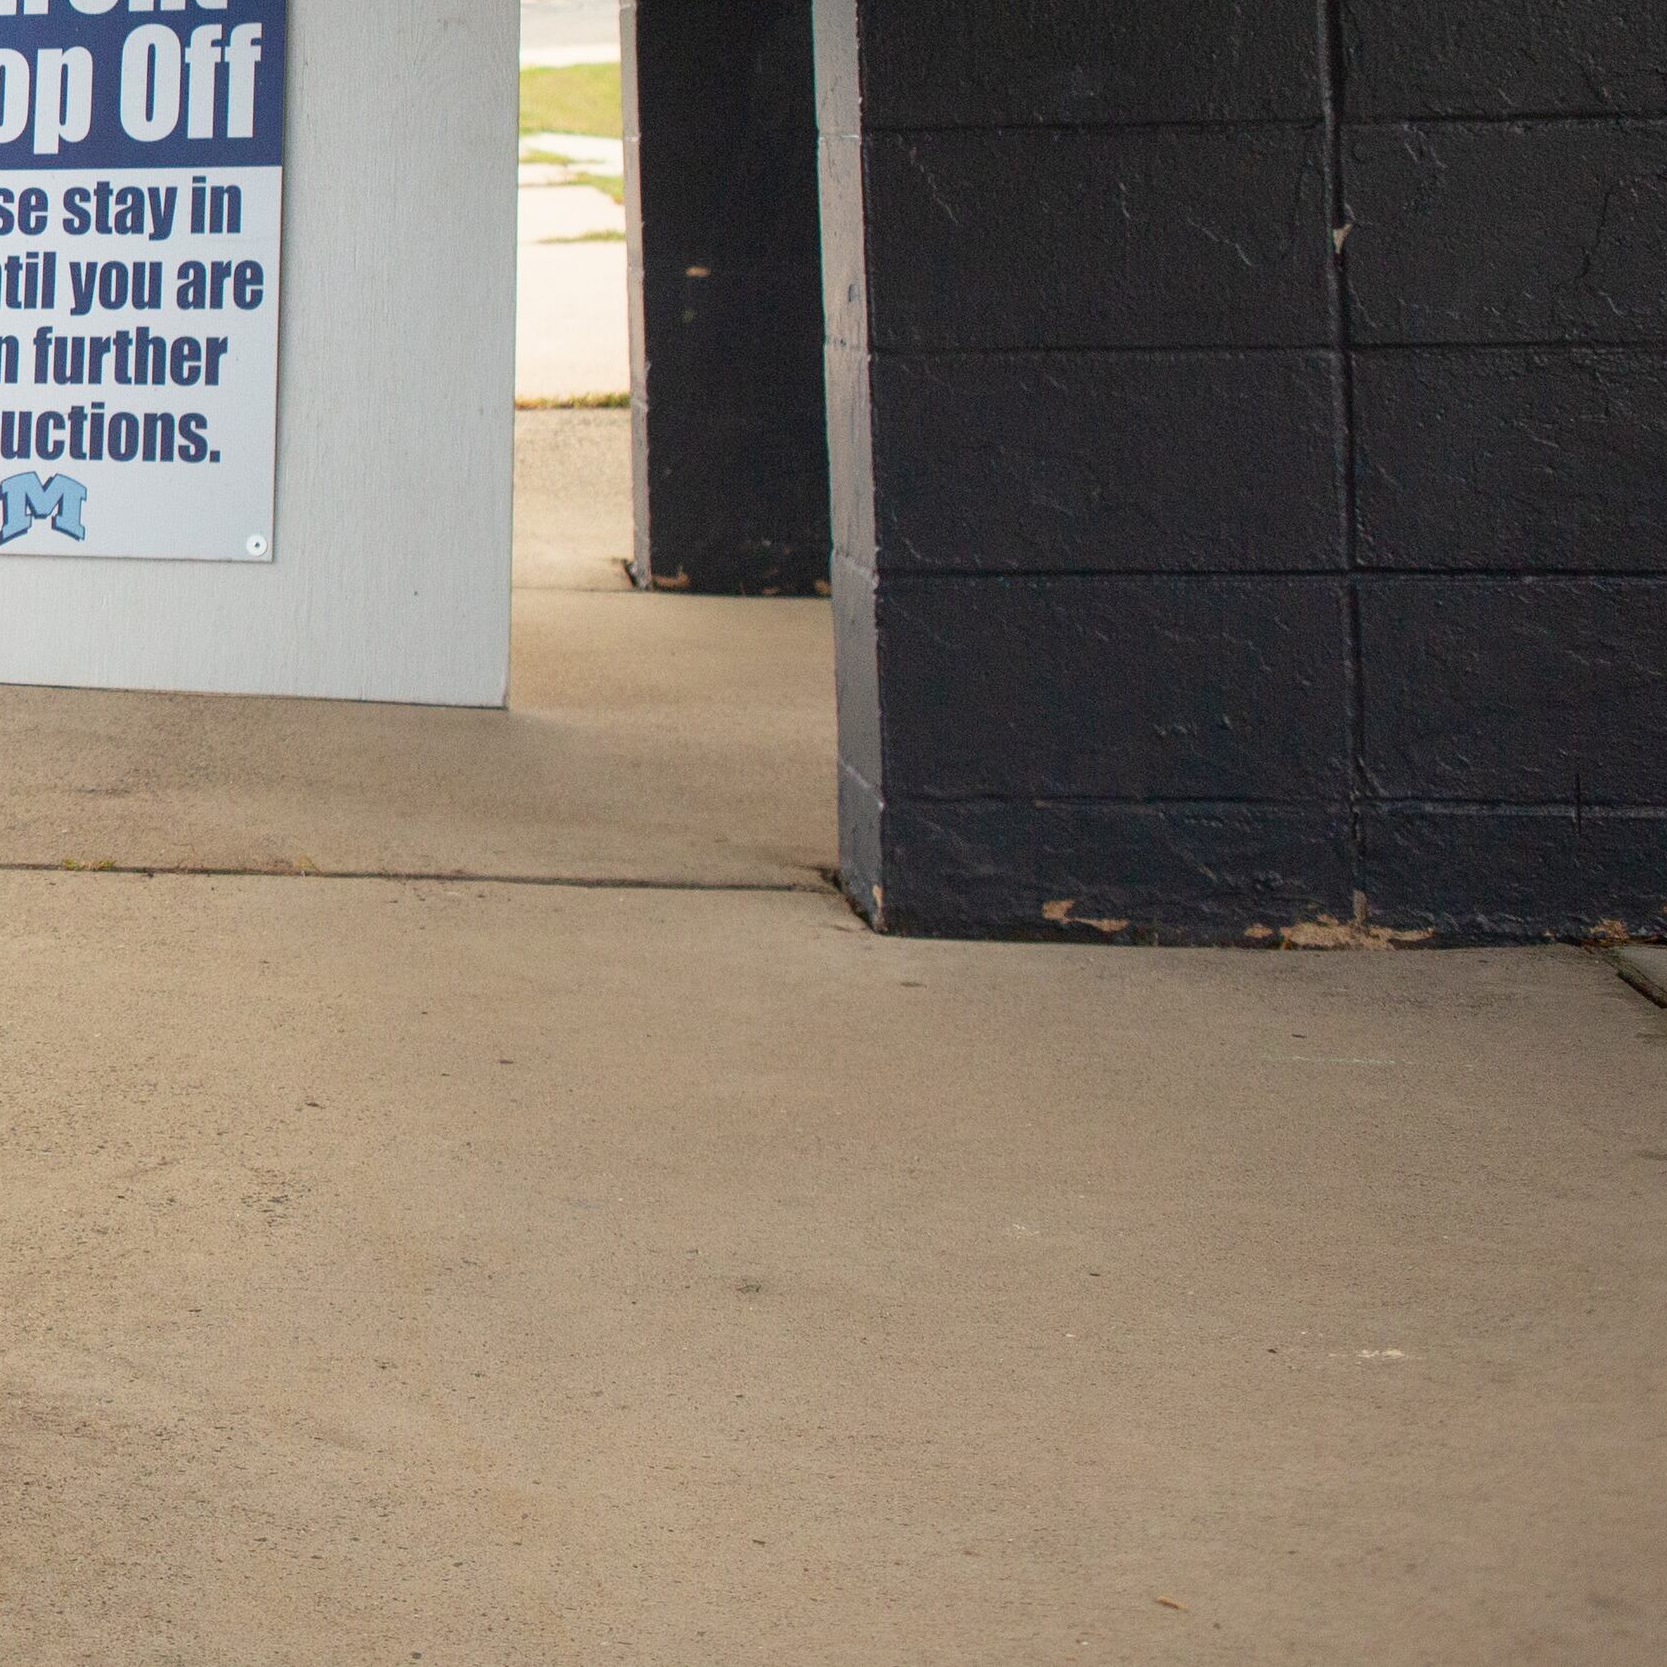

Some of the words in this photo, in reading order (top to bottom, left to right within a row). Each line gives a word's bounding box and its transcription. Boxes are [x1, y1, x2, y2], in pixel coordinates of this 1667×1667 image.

[119, 23, 262, 141] Off
[62, 180, 178, 241] stay
[190, 176, 242, 234] in
[69, 260, 163, 315] you
[176, 257, 264, 310] are
[33, 326, 227, 386] further
